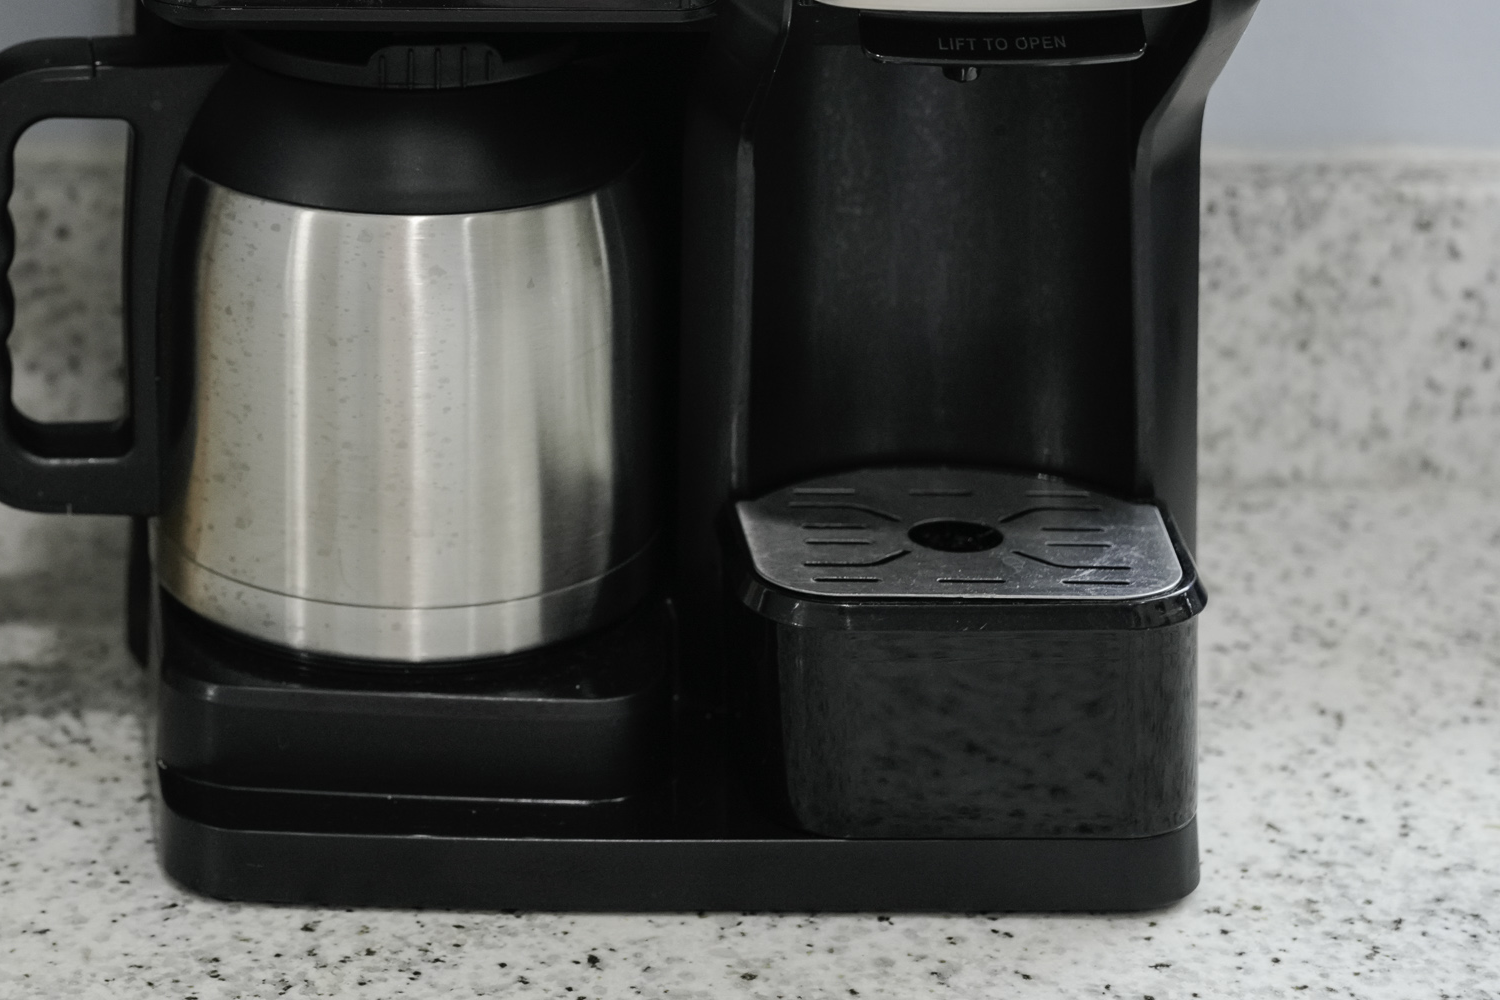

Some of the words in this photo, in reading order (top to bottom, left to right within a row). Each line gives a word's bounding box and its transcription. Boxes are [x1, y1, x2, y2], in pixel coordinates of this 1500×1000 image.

[938, 37, 976, 50] LIFT
[984, 37, 1008, 50] TO
[1015, 35, 1067, 49] OPEN
